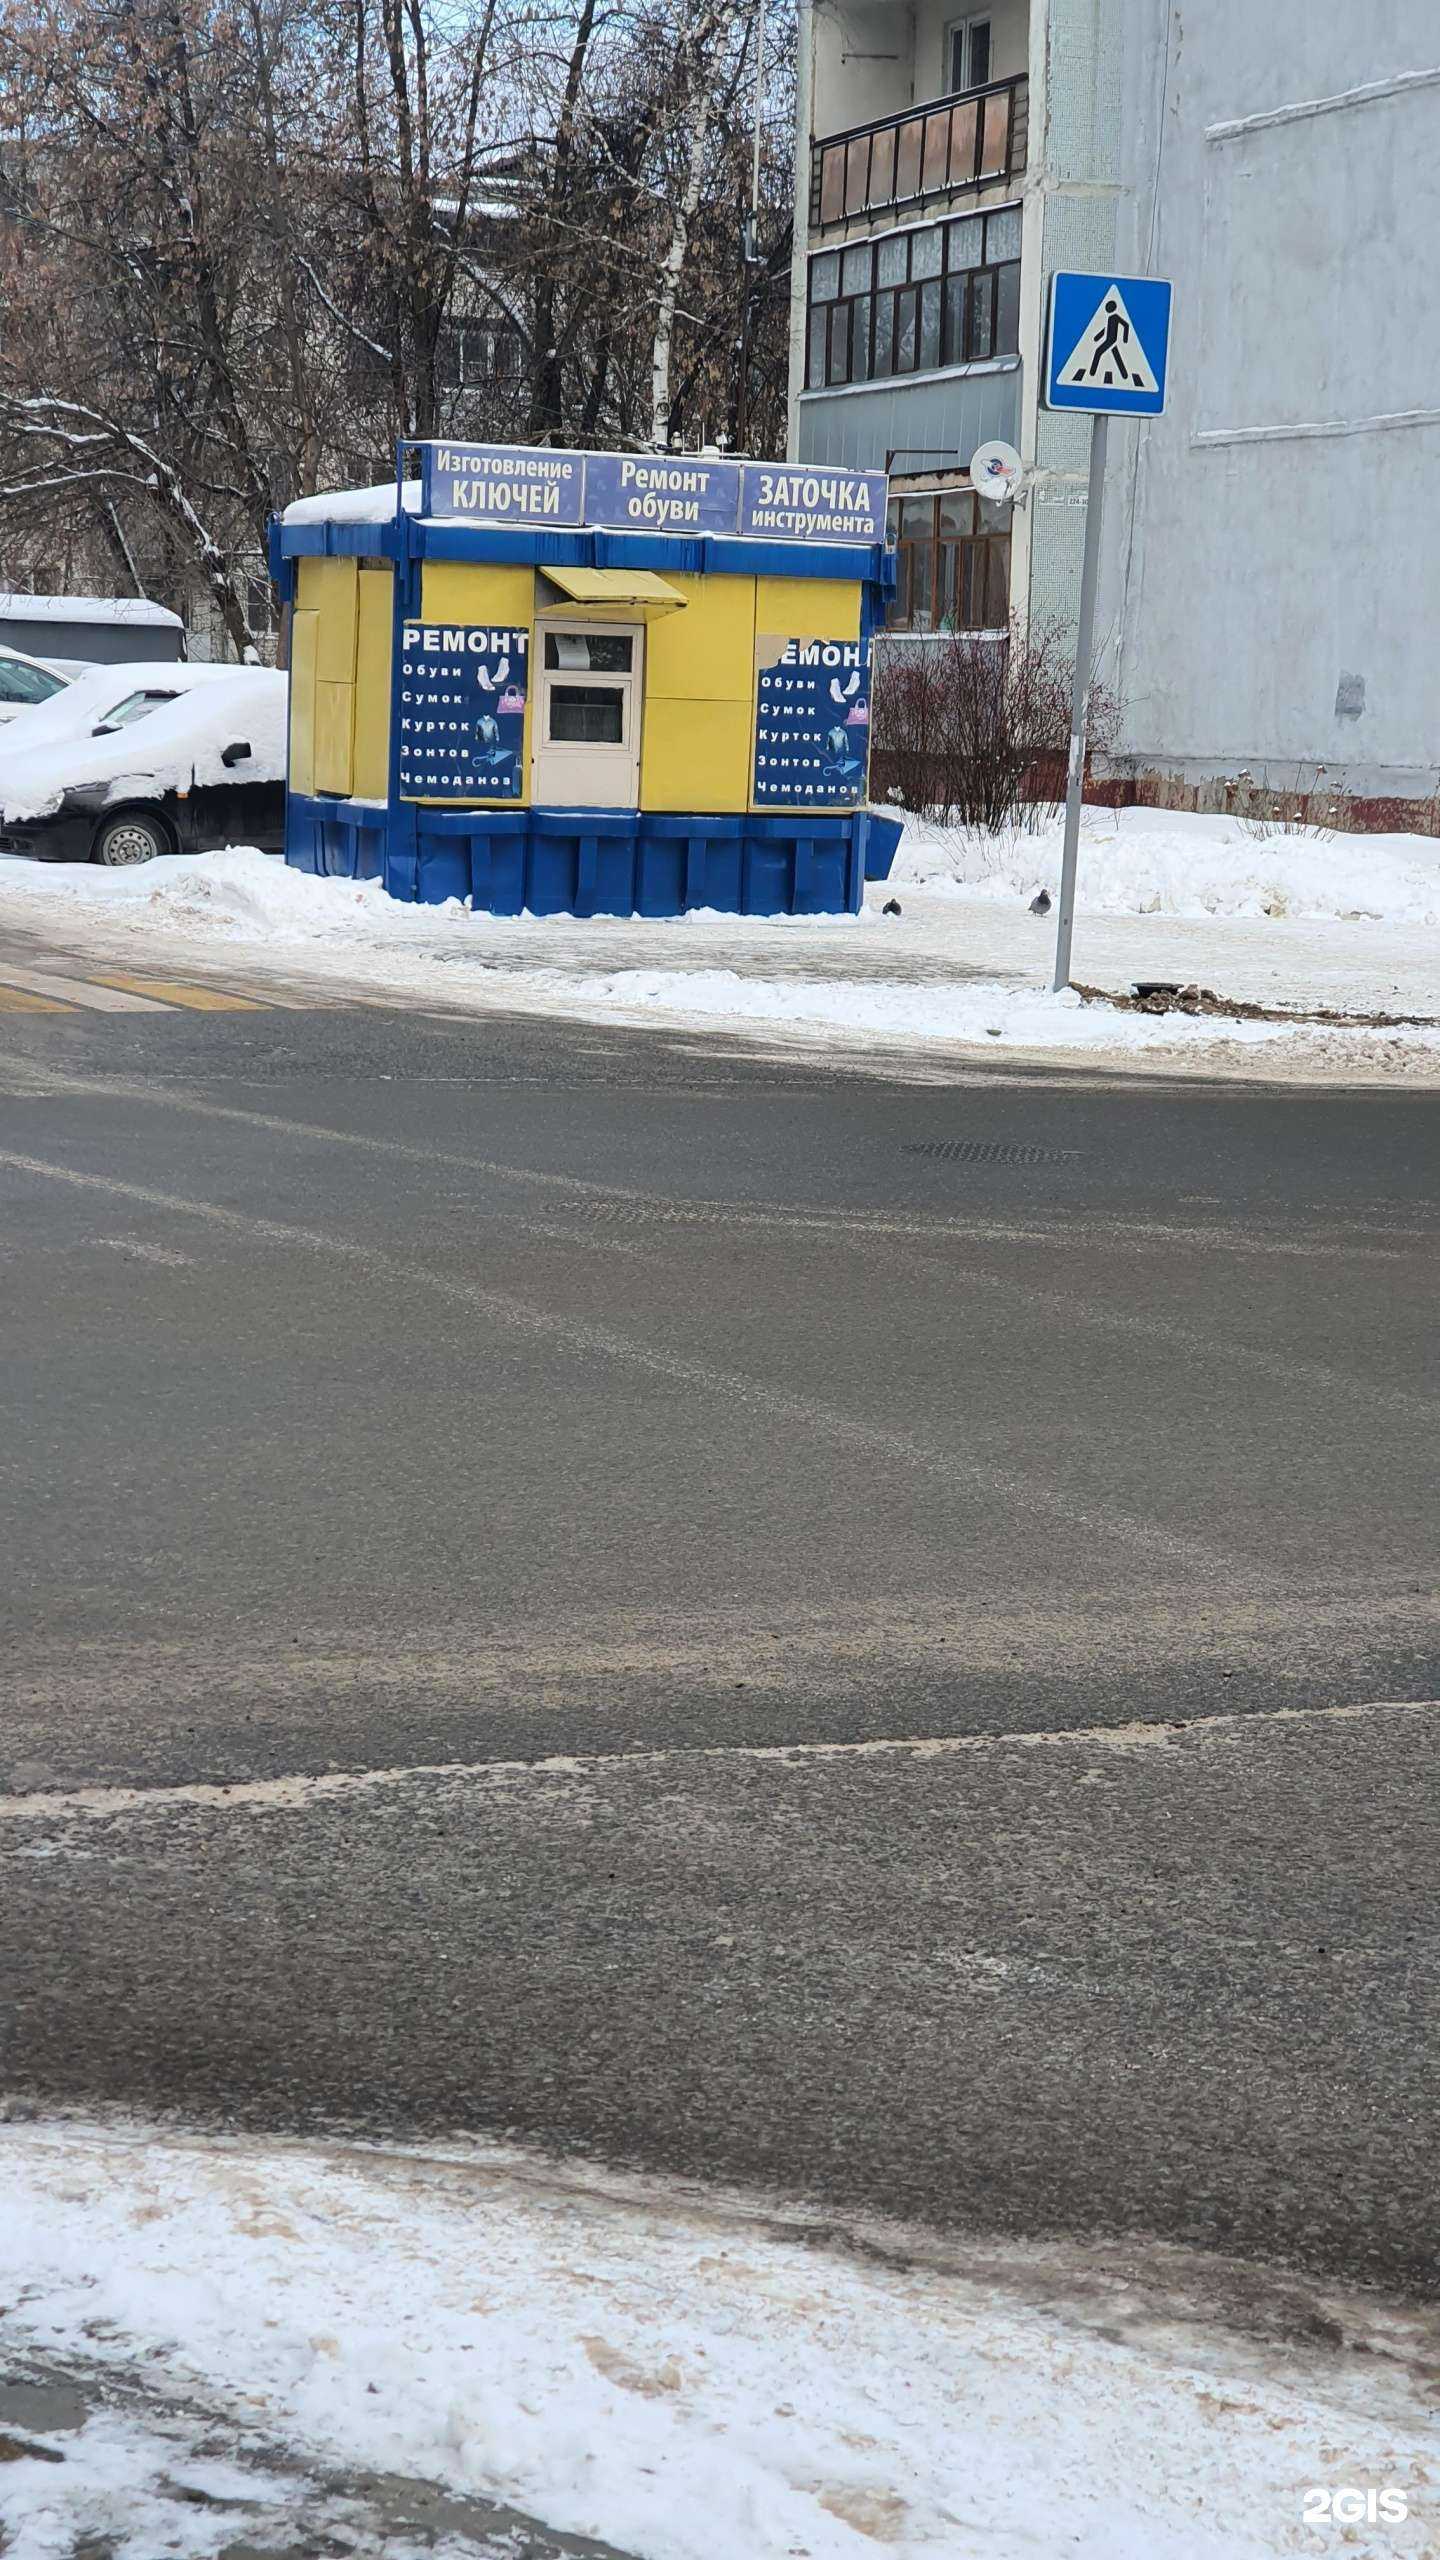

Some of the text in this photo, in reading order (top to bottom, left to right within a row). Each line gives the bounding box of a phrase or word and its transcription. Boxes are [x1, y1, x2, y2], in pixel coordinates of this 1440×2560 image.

[437, 449, 573, 479] Изготовление
[621, 461, 710, 492] Ремонт
[453, 480, 560, 514] КЛЮЧЕЙ
[758, 475, 870, 512] ЗАТОЧКА
[628, 492, 699, 526] обуви
[751, 510, 874, 535] инструмента
[403, 629, 529, 654] РЕМОНТ
[402, 664, 461, 678] Обуви
[761, 677, 815, 690] Обуви
[402, 691, 462, 705] Сумок
[760, 703, 815, 716] Сумок
[402, 718, 469, 732] Курток
[759, 729, 821, 742] Курток
[401, 745, 469, 758] Зонтов
[758, 755, 821, 768] Зонтов
[400, 772, 511, 786] Чемоданов
[757, 781, 858, 795] Чемоданов
